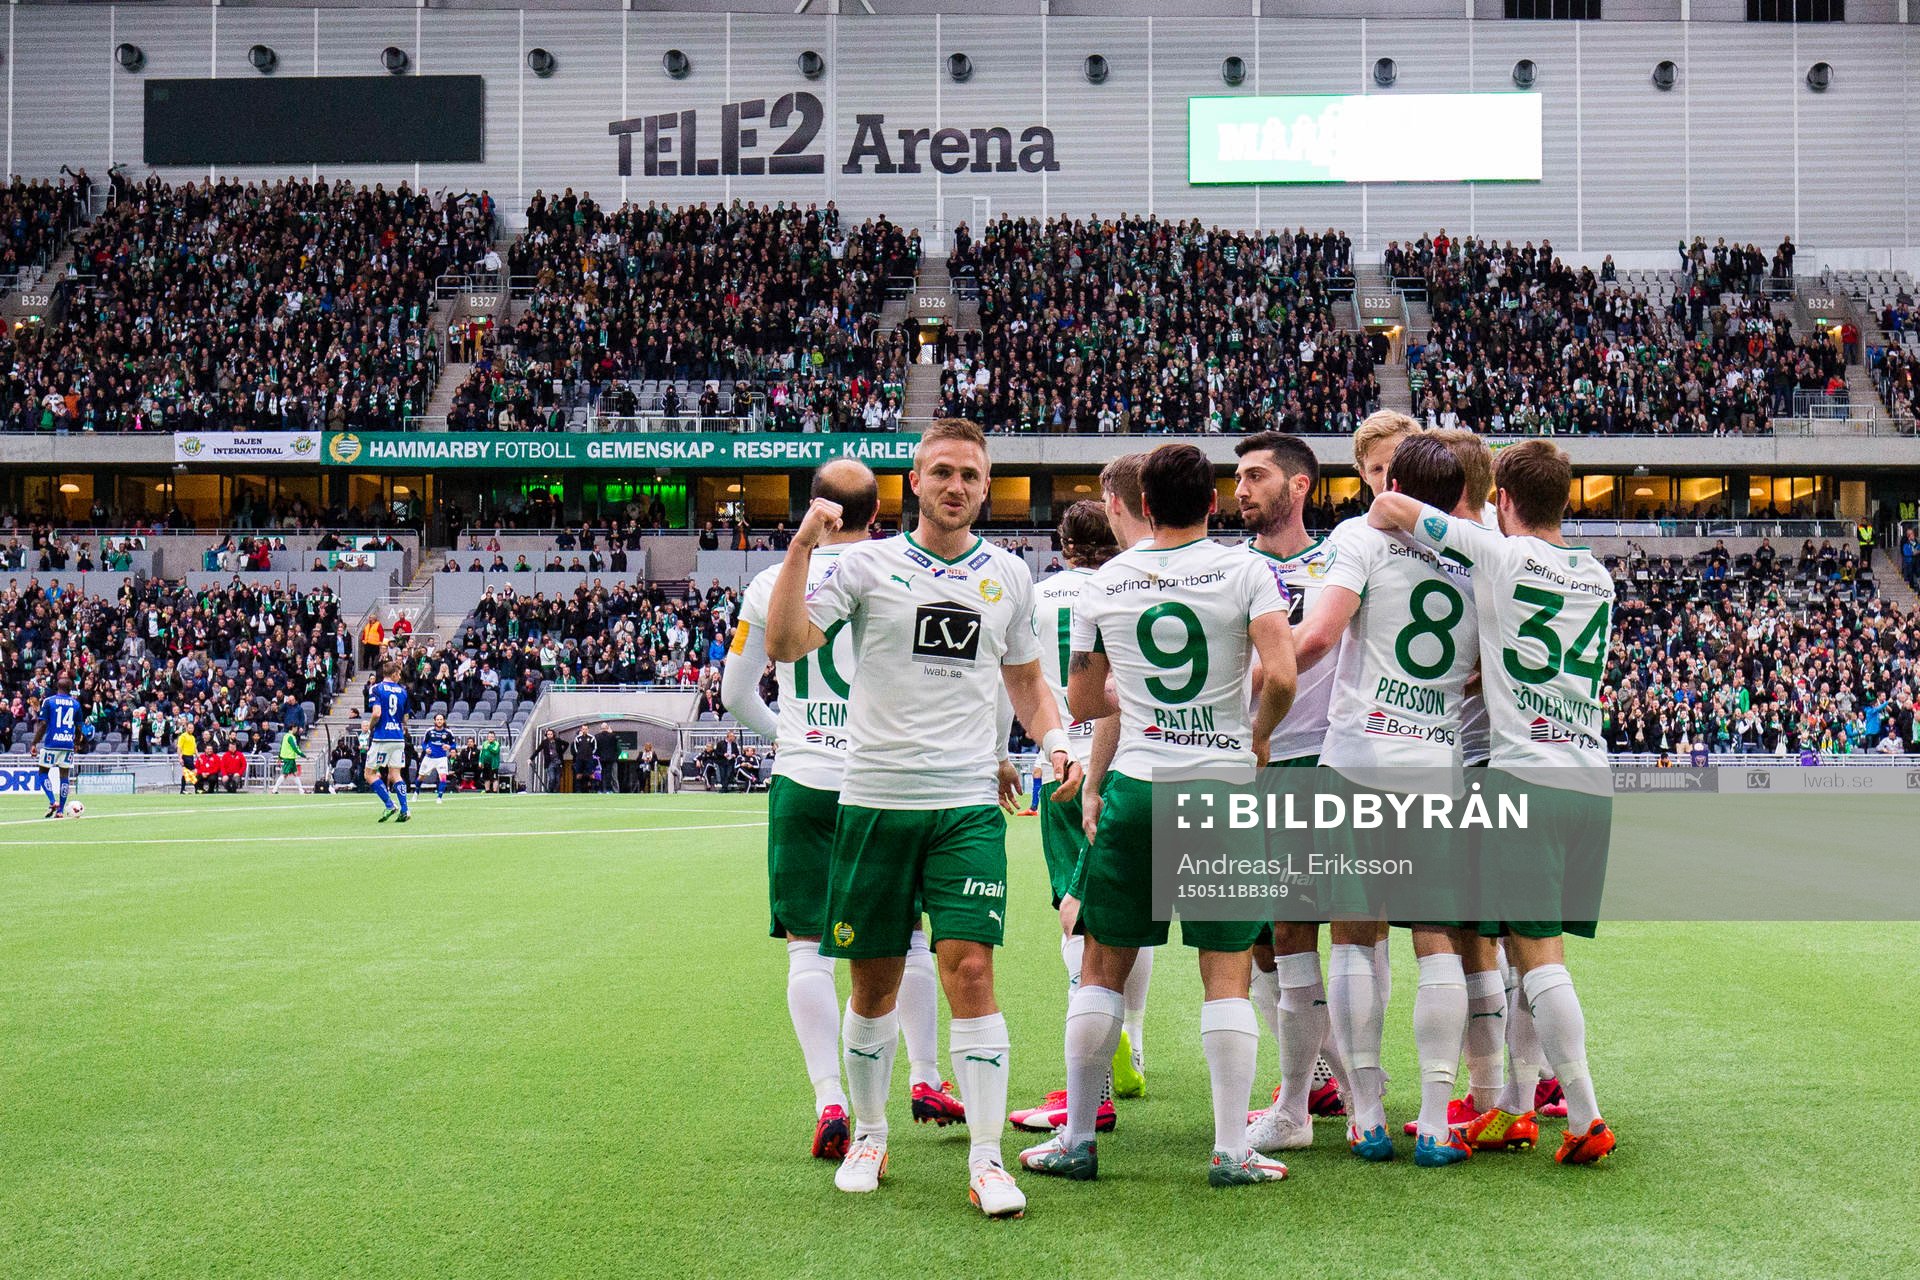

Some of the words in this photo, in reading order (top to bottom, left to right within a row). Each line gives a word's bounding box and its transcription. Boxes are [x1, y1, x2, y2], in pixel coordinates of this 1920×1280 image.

[609, 91, 824, 176] TELE2
[842, 114, 1060, 173] Arena
[22, 296, 48, 306] B328
[471, 297, 497, 307] B327
[919, 298, 946, 308] B326
[1365, 298, 1391, 308] B325
[1809, 299, 1834, 309] B324
[370, 442, 491, 459] HAMMARBY
[496, 443, 575, 459] FOTBOLL
[587, 442, 715, 459] GEMENSKAP
[733, 442, 824, 459] RESPEKT
[1389, 543, 1430, 563] Sefina
[1524, 558, 1565, 585] Sefina
[1106, 579, 1150, 595] Sefina
[1158, 570, 1226, 591] pantbank
[387, 608, 419, 620] A27
[918, 615, 979, 650] LW
[1395, 579, 1464, 680] 8
[1503, 583, 1609, 700] 34
[1136, 602, 1209, 704] 9
[924, 665, 963, 678] lwab.se
[389, 694, 398, 717] 9
[1375, 677, 1445, 716] PERSSON
[56, 706, 74, 729] 14
[1387, 719, 1455, 746] Botrygg
[1640, 772, 1687, 789] PUMA
[1804, 773, 1873, 789] lwab.se
